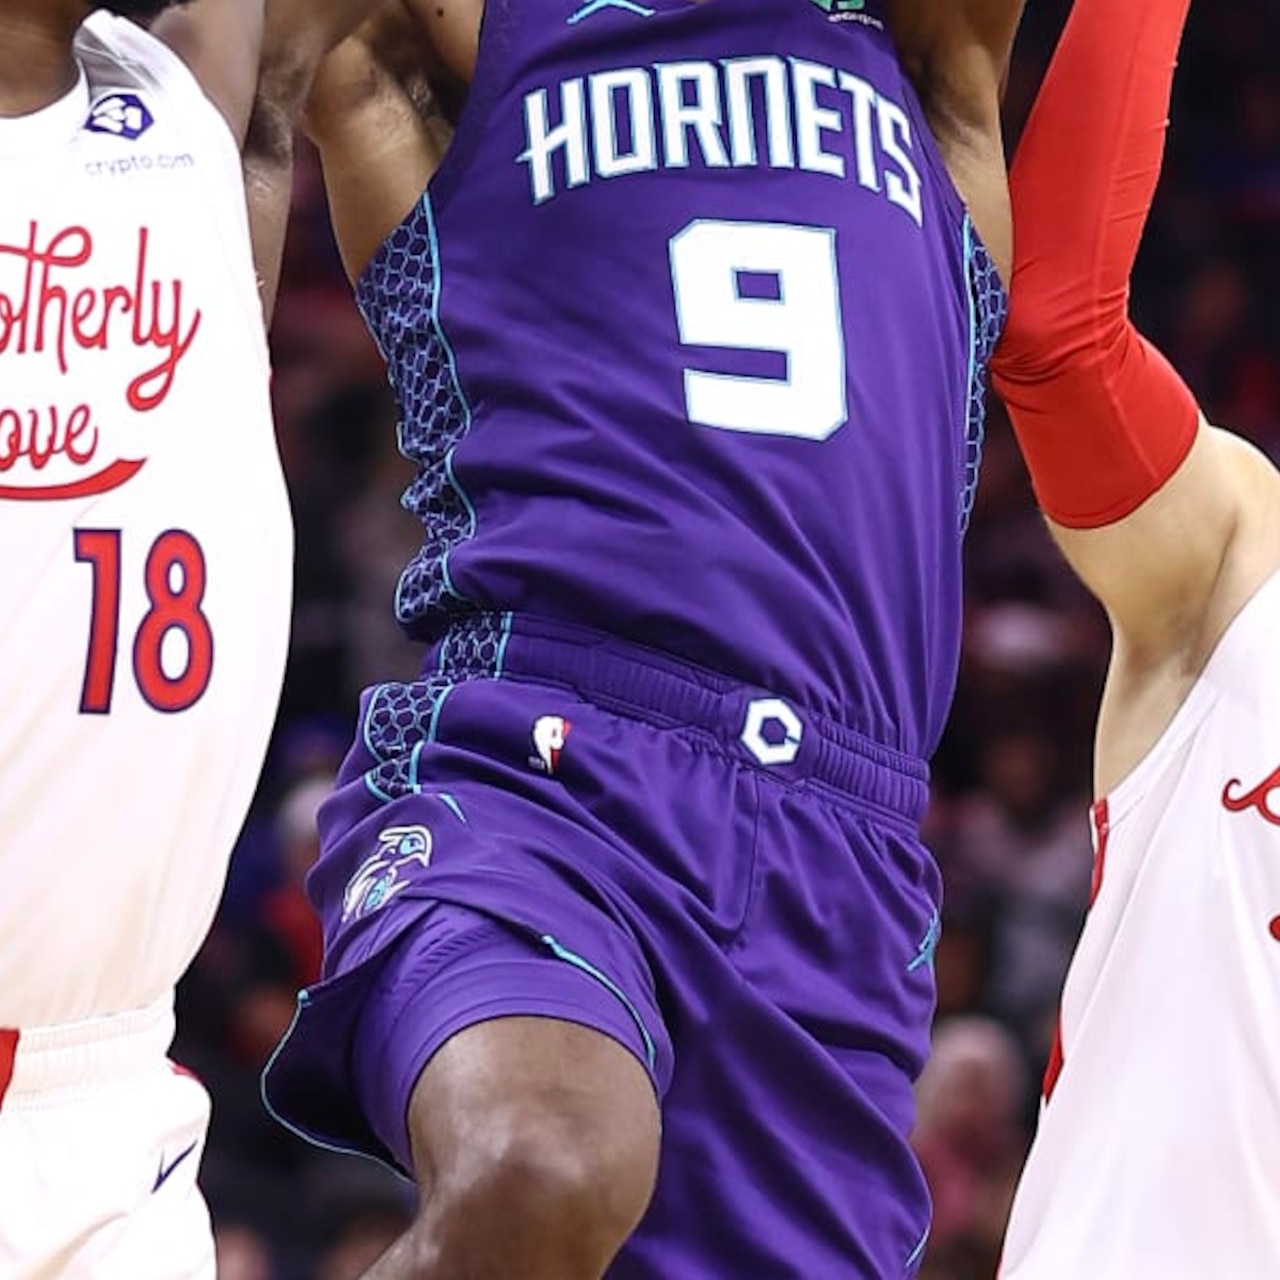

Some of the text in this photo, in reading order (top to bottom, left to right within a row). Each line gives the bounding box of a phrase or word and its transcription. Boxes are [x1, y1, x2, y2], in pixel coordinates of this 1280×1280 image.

[516, 54, 922, 227] HORNETS
[668, 218, 848, 442] 9
[72, 527, 215, 715] 18
